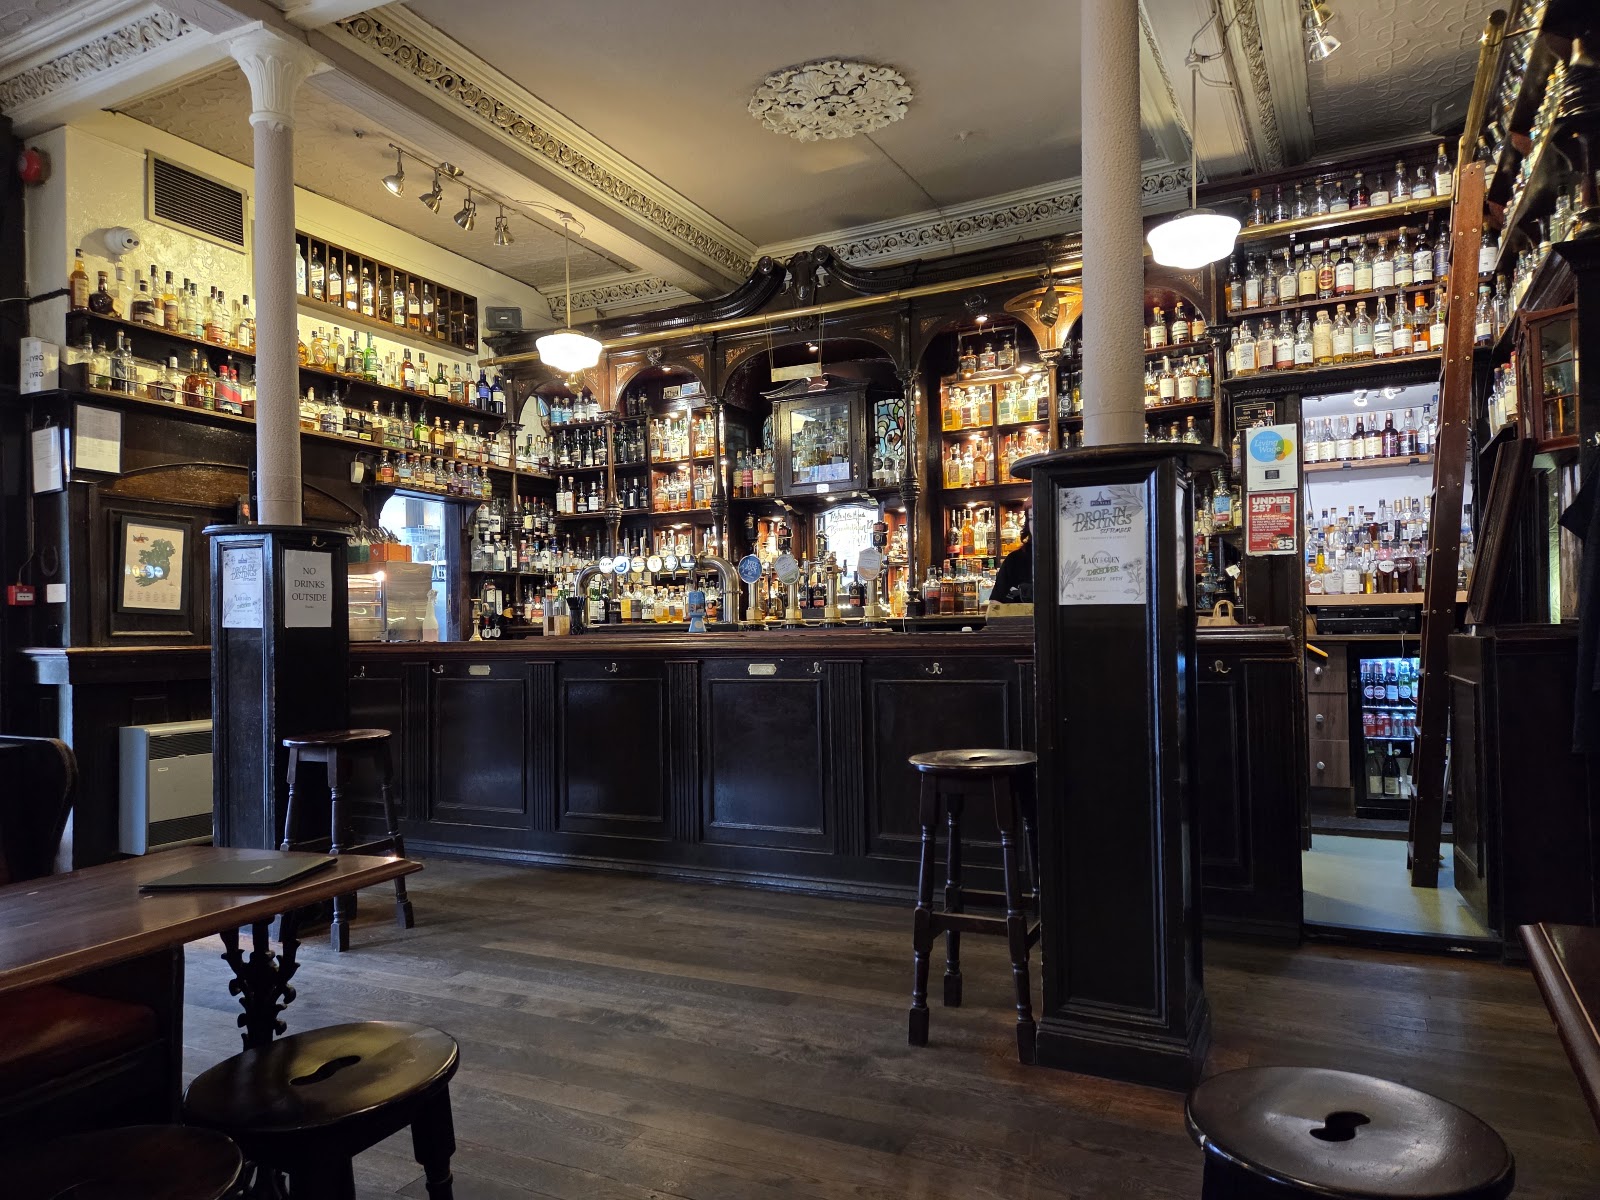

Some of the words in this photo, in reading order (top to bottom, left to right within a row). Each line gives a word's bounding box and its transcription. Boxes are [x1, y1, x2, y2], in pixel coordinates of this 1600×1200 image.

[1259, 446, 1281, 454] Wage
[1252, 496, 1291, 505] UNDER
[1252, 504, 1271, 512] 25?
[1076, 506, 1127, 522] DROP-IN
[1072, 514, 1132, 532] TASTINGS
[1083, 557, 1099, 565] LADY
[303, 567, 316, 575] NO
[294, 580, 325, 588] DRINKS
[291, 593, 327, 601] OUTSIDE
